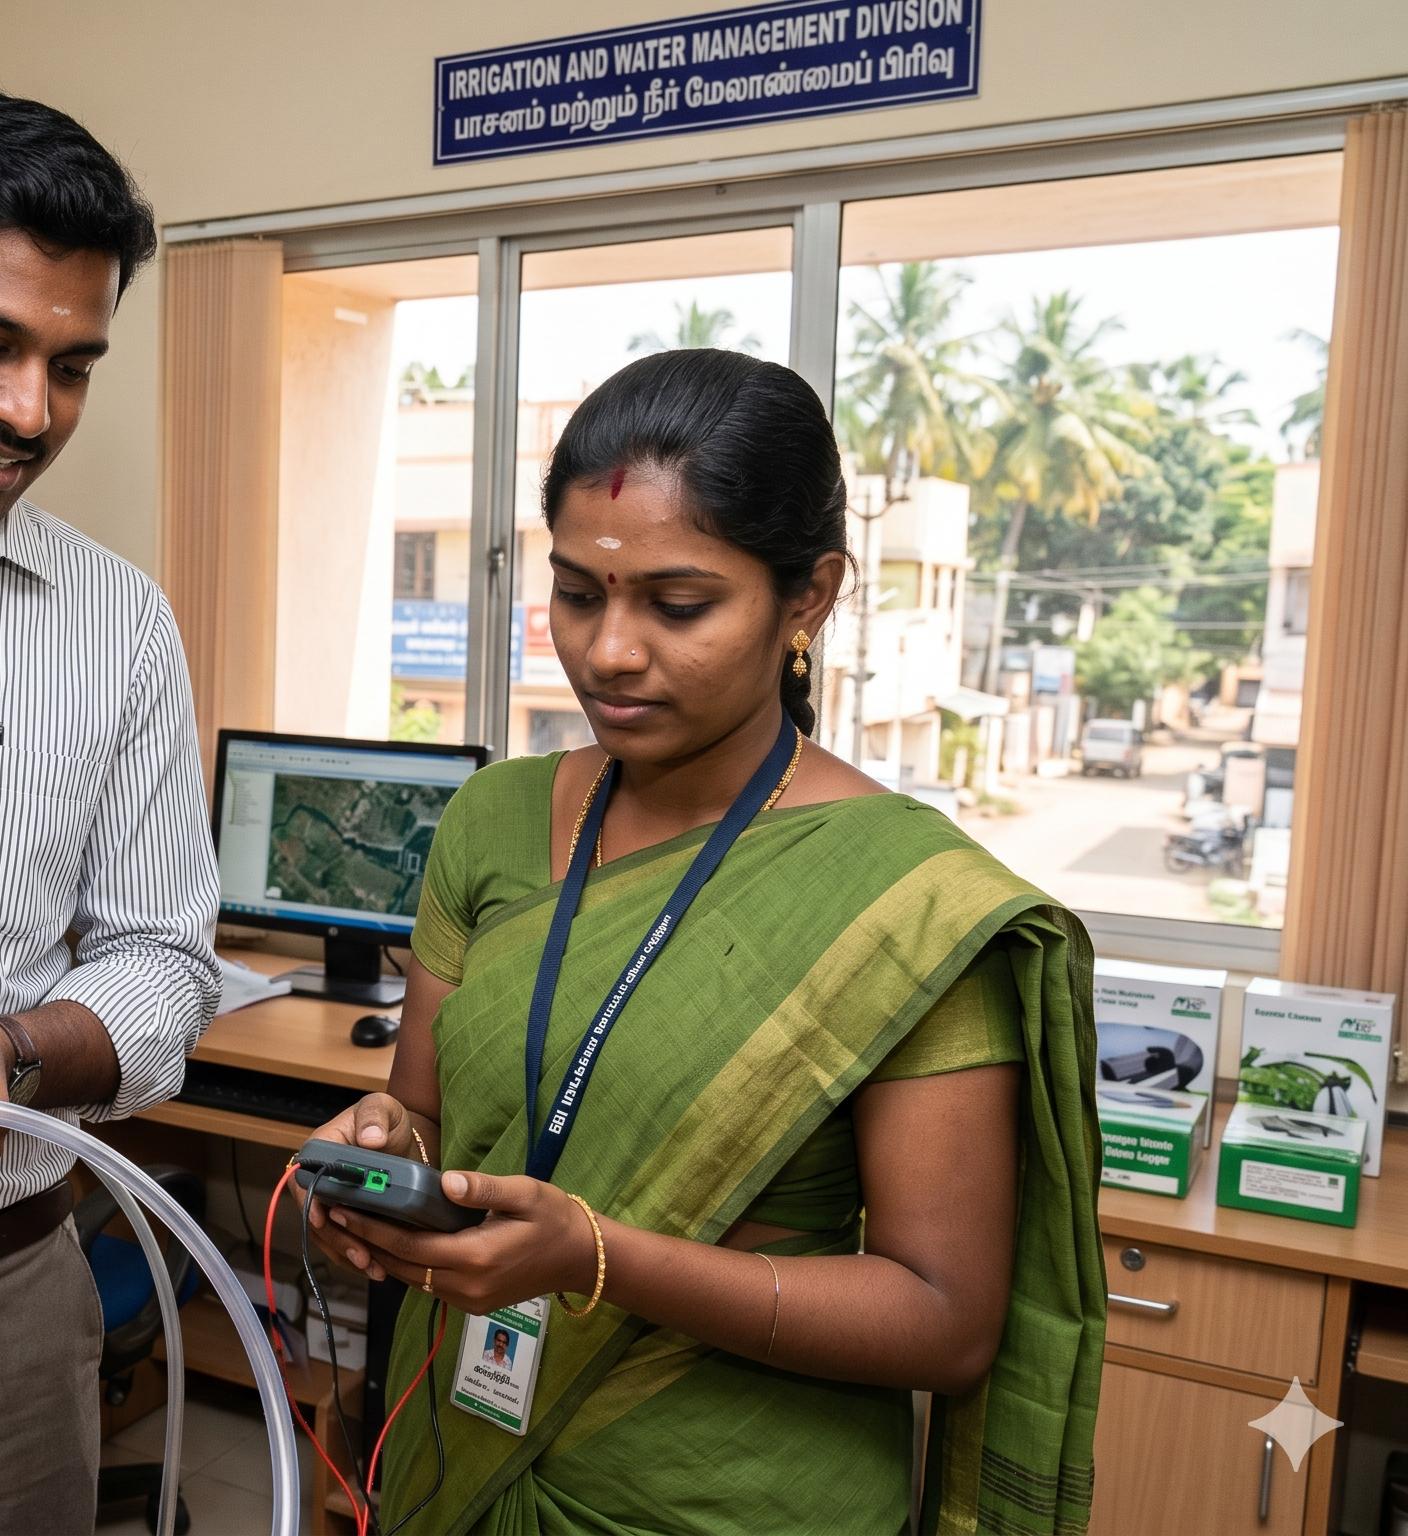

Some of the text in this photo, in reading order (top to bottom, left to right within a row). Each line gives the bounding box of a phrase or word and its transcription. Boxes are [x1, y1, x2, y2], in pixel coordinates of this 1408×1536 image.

[449, 0, 963, 100] IRRIGATION AND WATER MANAGEMENT DIVISION
[454, 41, 955, 140] பாசனம் மற்றும் நீர் மேலாண்மைப் பிரிவு
